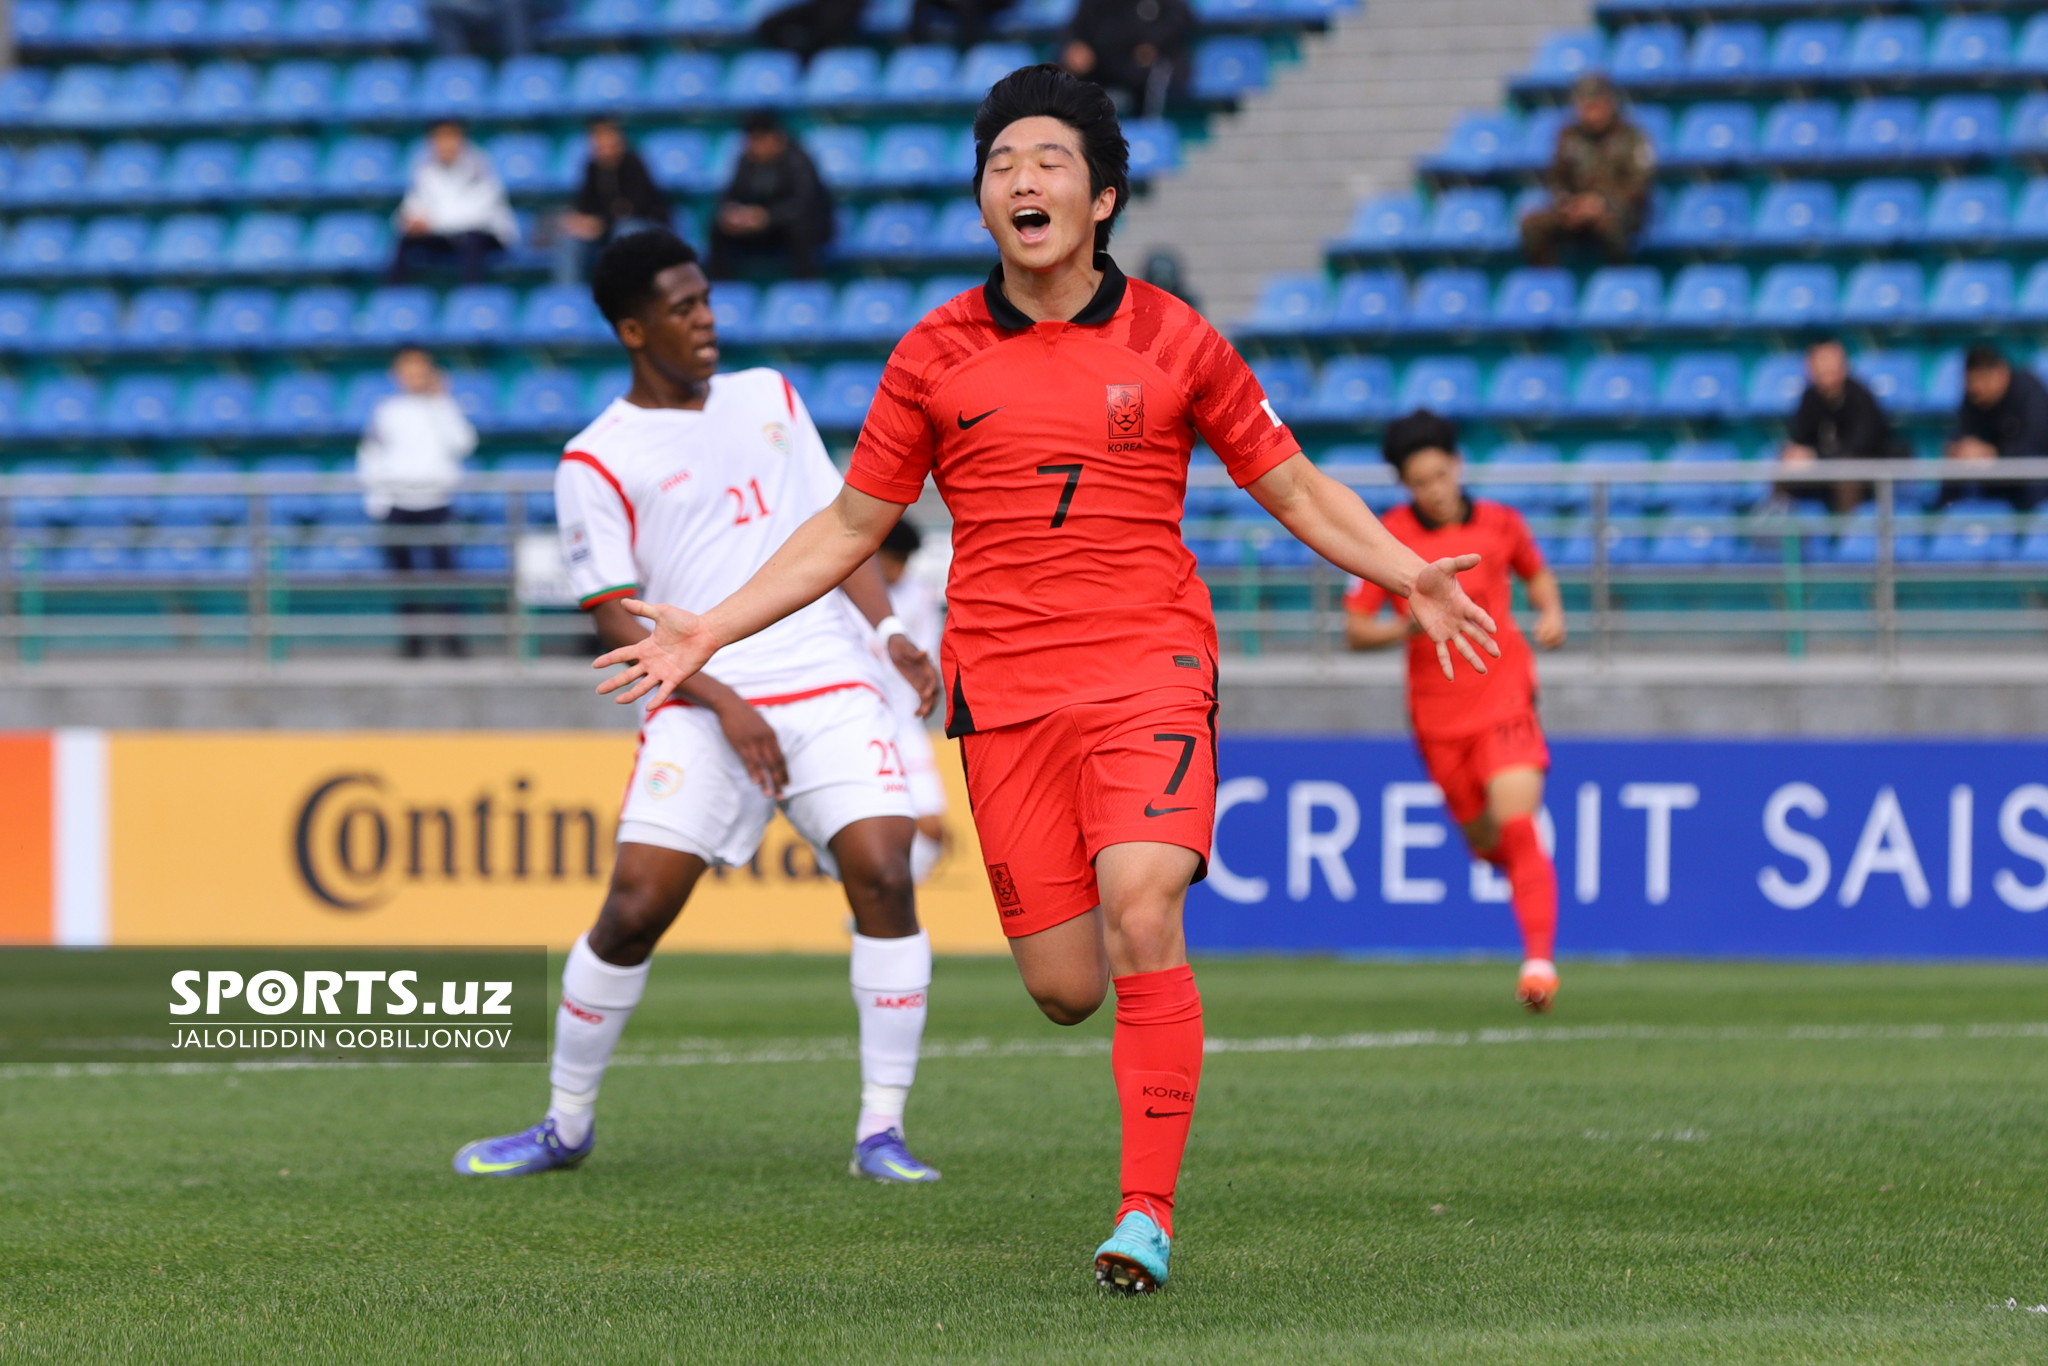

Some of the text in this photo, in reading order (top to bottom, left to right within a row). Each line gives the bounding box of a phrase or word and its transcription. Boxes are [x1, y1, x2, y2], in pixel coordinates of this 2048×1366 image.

[1107, 442, 1142, 453] KOREA
[724, 477, 772, 526] 21
[1036, 463, 1084, 529] 7
[867, 738, 907, 777] 21
[1153, 733, 1197, 796] 7
